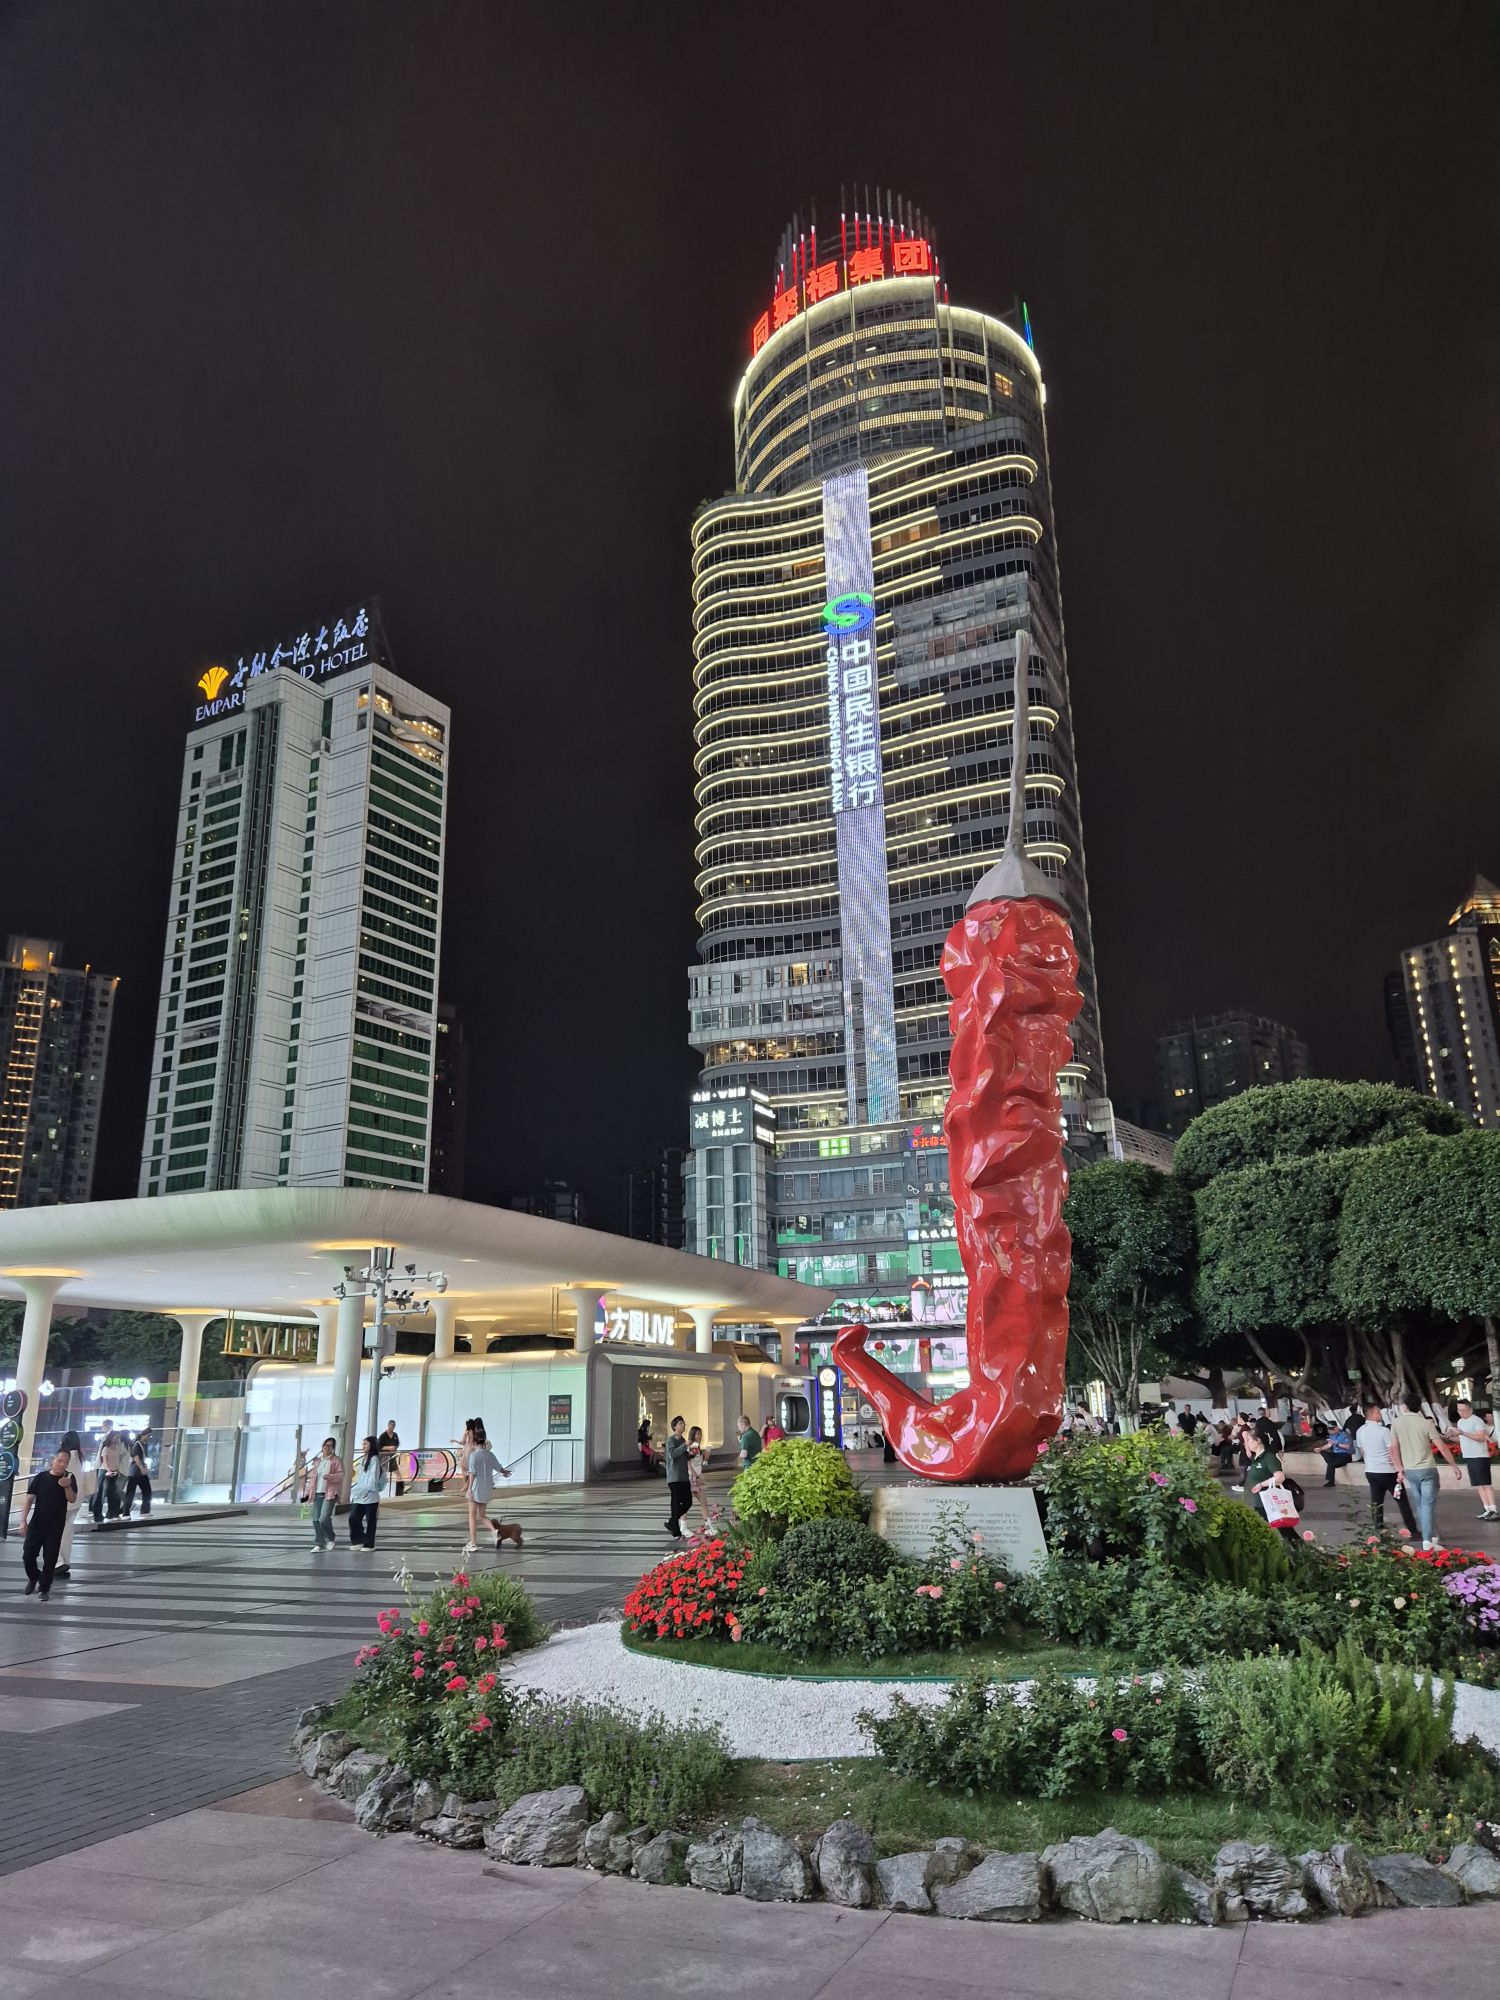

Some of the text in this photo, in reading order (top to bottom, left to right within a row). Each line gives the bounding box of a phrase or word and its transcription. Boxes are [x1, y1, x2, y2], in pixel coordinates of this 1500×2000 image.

[320, 642, 368, 674] HOTEL
[826, 647, 843, 813] CHINA MINSHENG BANK
[842, 638, 878, 807] 中国民生银行
